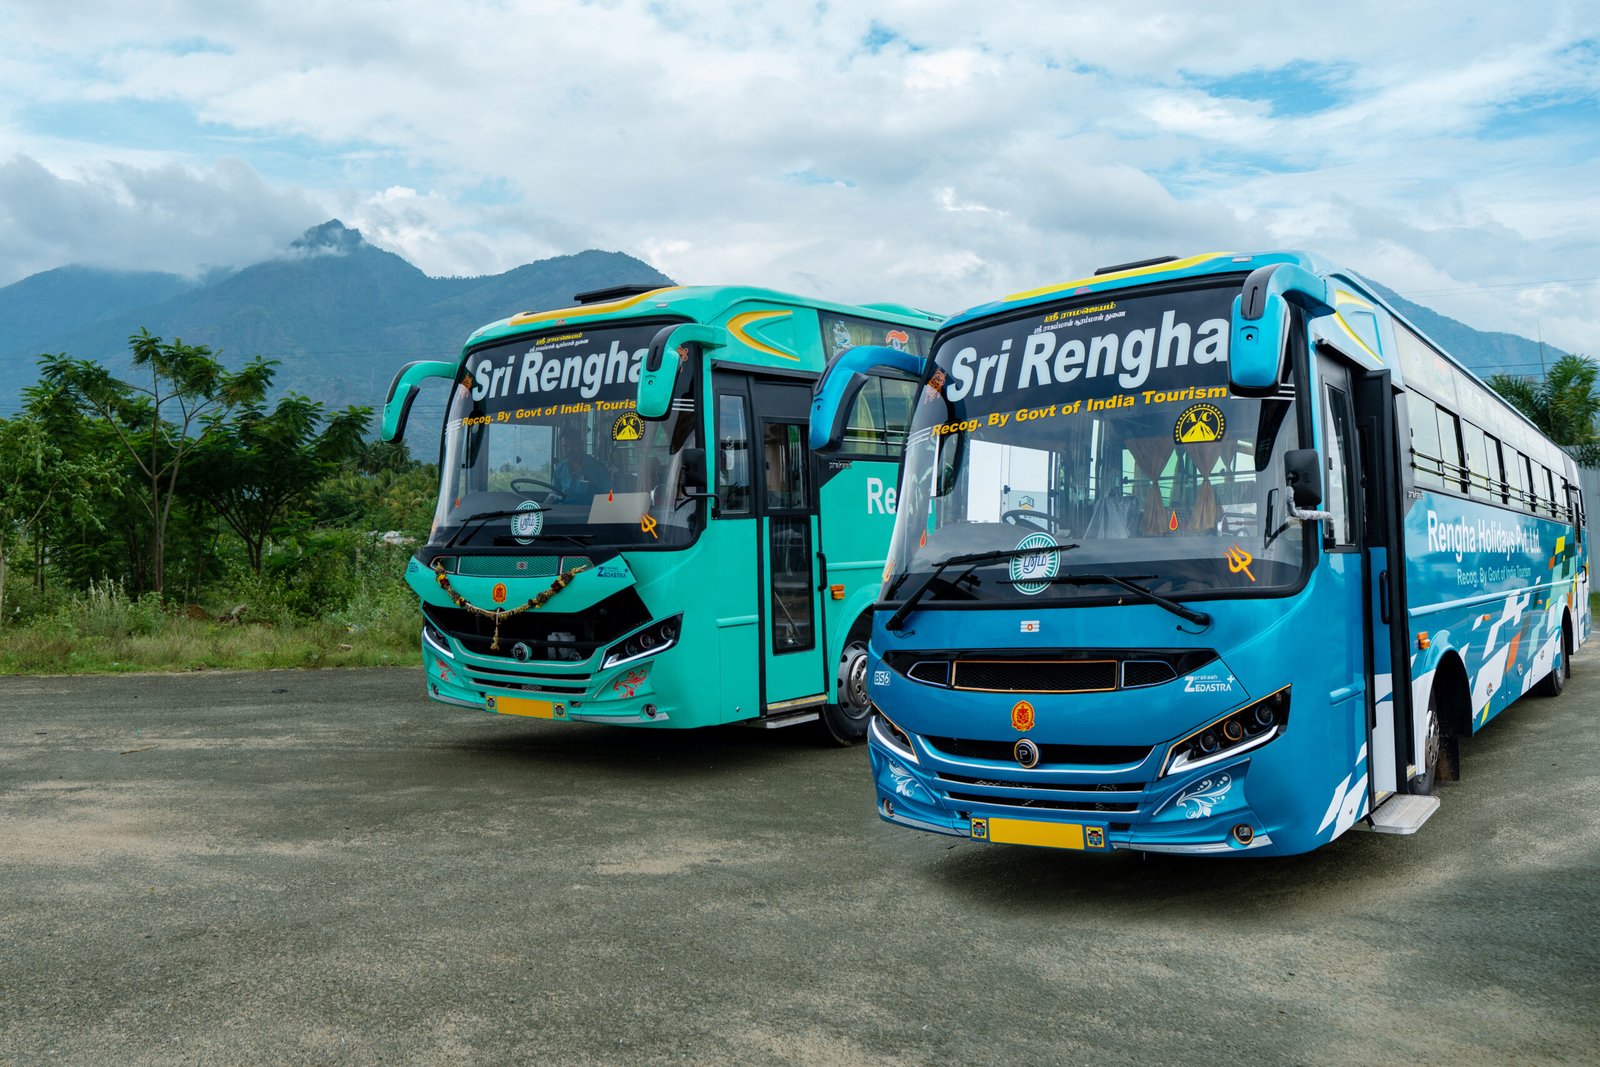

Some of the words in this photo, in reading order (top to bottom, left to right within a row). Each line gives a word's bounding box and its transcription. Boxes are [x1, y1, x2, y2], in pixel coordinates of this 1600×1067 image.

[472, 355, 515, 401] Sri
[516, 341, 649, 399] Rengha
[946, 339, 1013, 402] Sri
[1017, 310, 1228, 388] Rengha
[461, 415, 494, 427] Recog.
[497, 411, 511, 423] By
[515, 407, 542, 420] Govt
[544, 404, 558, 416] of
[560, 402, 591, 415] India
[595, 399, 636, 411] Touris
[931, 418, 982, 437] Recog.
[988, 412, 1010, 427] By
[1015, 404, 1057, 422] Govt
[1061, 400, 1081, 415] of
[1086, 394, 1135, 412] India
[1142, 386, 1227, 404] Tourism
[1186, 411, 1212, 423] A/C
[1427, 510, 1475, 563] Rengha
[1477, 519, 1515, 561] Holidays
[1457, 568, 1479, 588] Recog.
[1480, 567, 1487, 586] By
[1501, 566, 1506, 580] of
[1506, 565, 1516, 578] India
[1516, 565, 1531, 578] Tourism
